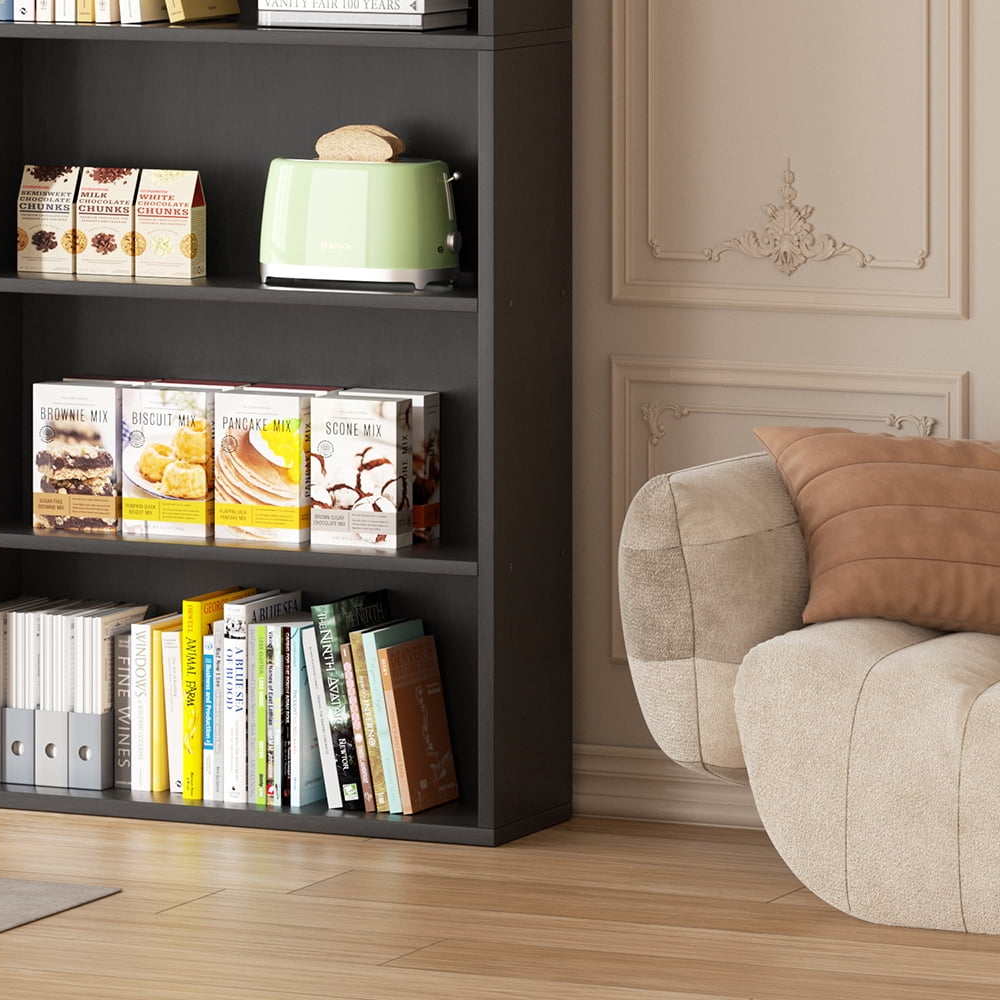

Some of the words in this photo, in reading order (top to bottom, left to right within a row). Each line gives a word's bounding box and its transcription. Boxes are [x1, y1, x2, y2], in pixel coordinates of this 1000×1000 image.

[364, 0, 401, 10] YEARS
[19, 203, 70, 211] CHUNKS
[78, 204, 130, 213] CHUNKS
[137, 200, 190, 208] CHOCOLATE
[137, 207, 189, 215] CHUNKS
[40, 407, 86, 422] BROWNIE
[90, 410, 108, 423] MIX
[131, 411, 172, 427] BISCUIT
[178, 414, 197, 428] MIX
[222, 416, 268, 432] PANCAKE
[273, 419, 292, 433] MIX
[325, 421, 359, 436] SCONE
[363, 423, 382, 438] MIX
[259, 603, 281, 621] BLUE
[282, 599, 298, 615] SEA
[316, 610, 329, 629] THE
[185, 636, 197, 677] ANIMAL
[226, 648, 233, 659] OF
[235, 646, 244, 655] A
[319, 629, 337, 672] NINTH
[135, 630, 147, 698] WINDOWS
[235, 658, 244, 689] BLUE
[118, 656, 130, 697] FINE
[204, 663, 212, 689] Business
[185, 680, 197, 707] FARM
[204, 692, 212, 703] and
[235, 691, 244, 712] SEA
[327, 676, 344, 723] AVATAR
[204, 705, 212, 738] Production
[362, 698, 376, 747] INFERNO
[118, 706, 130, 768] WINES
